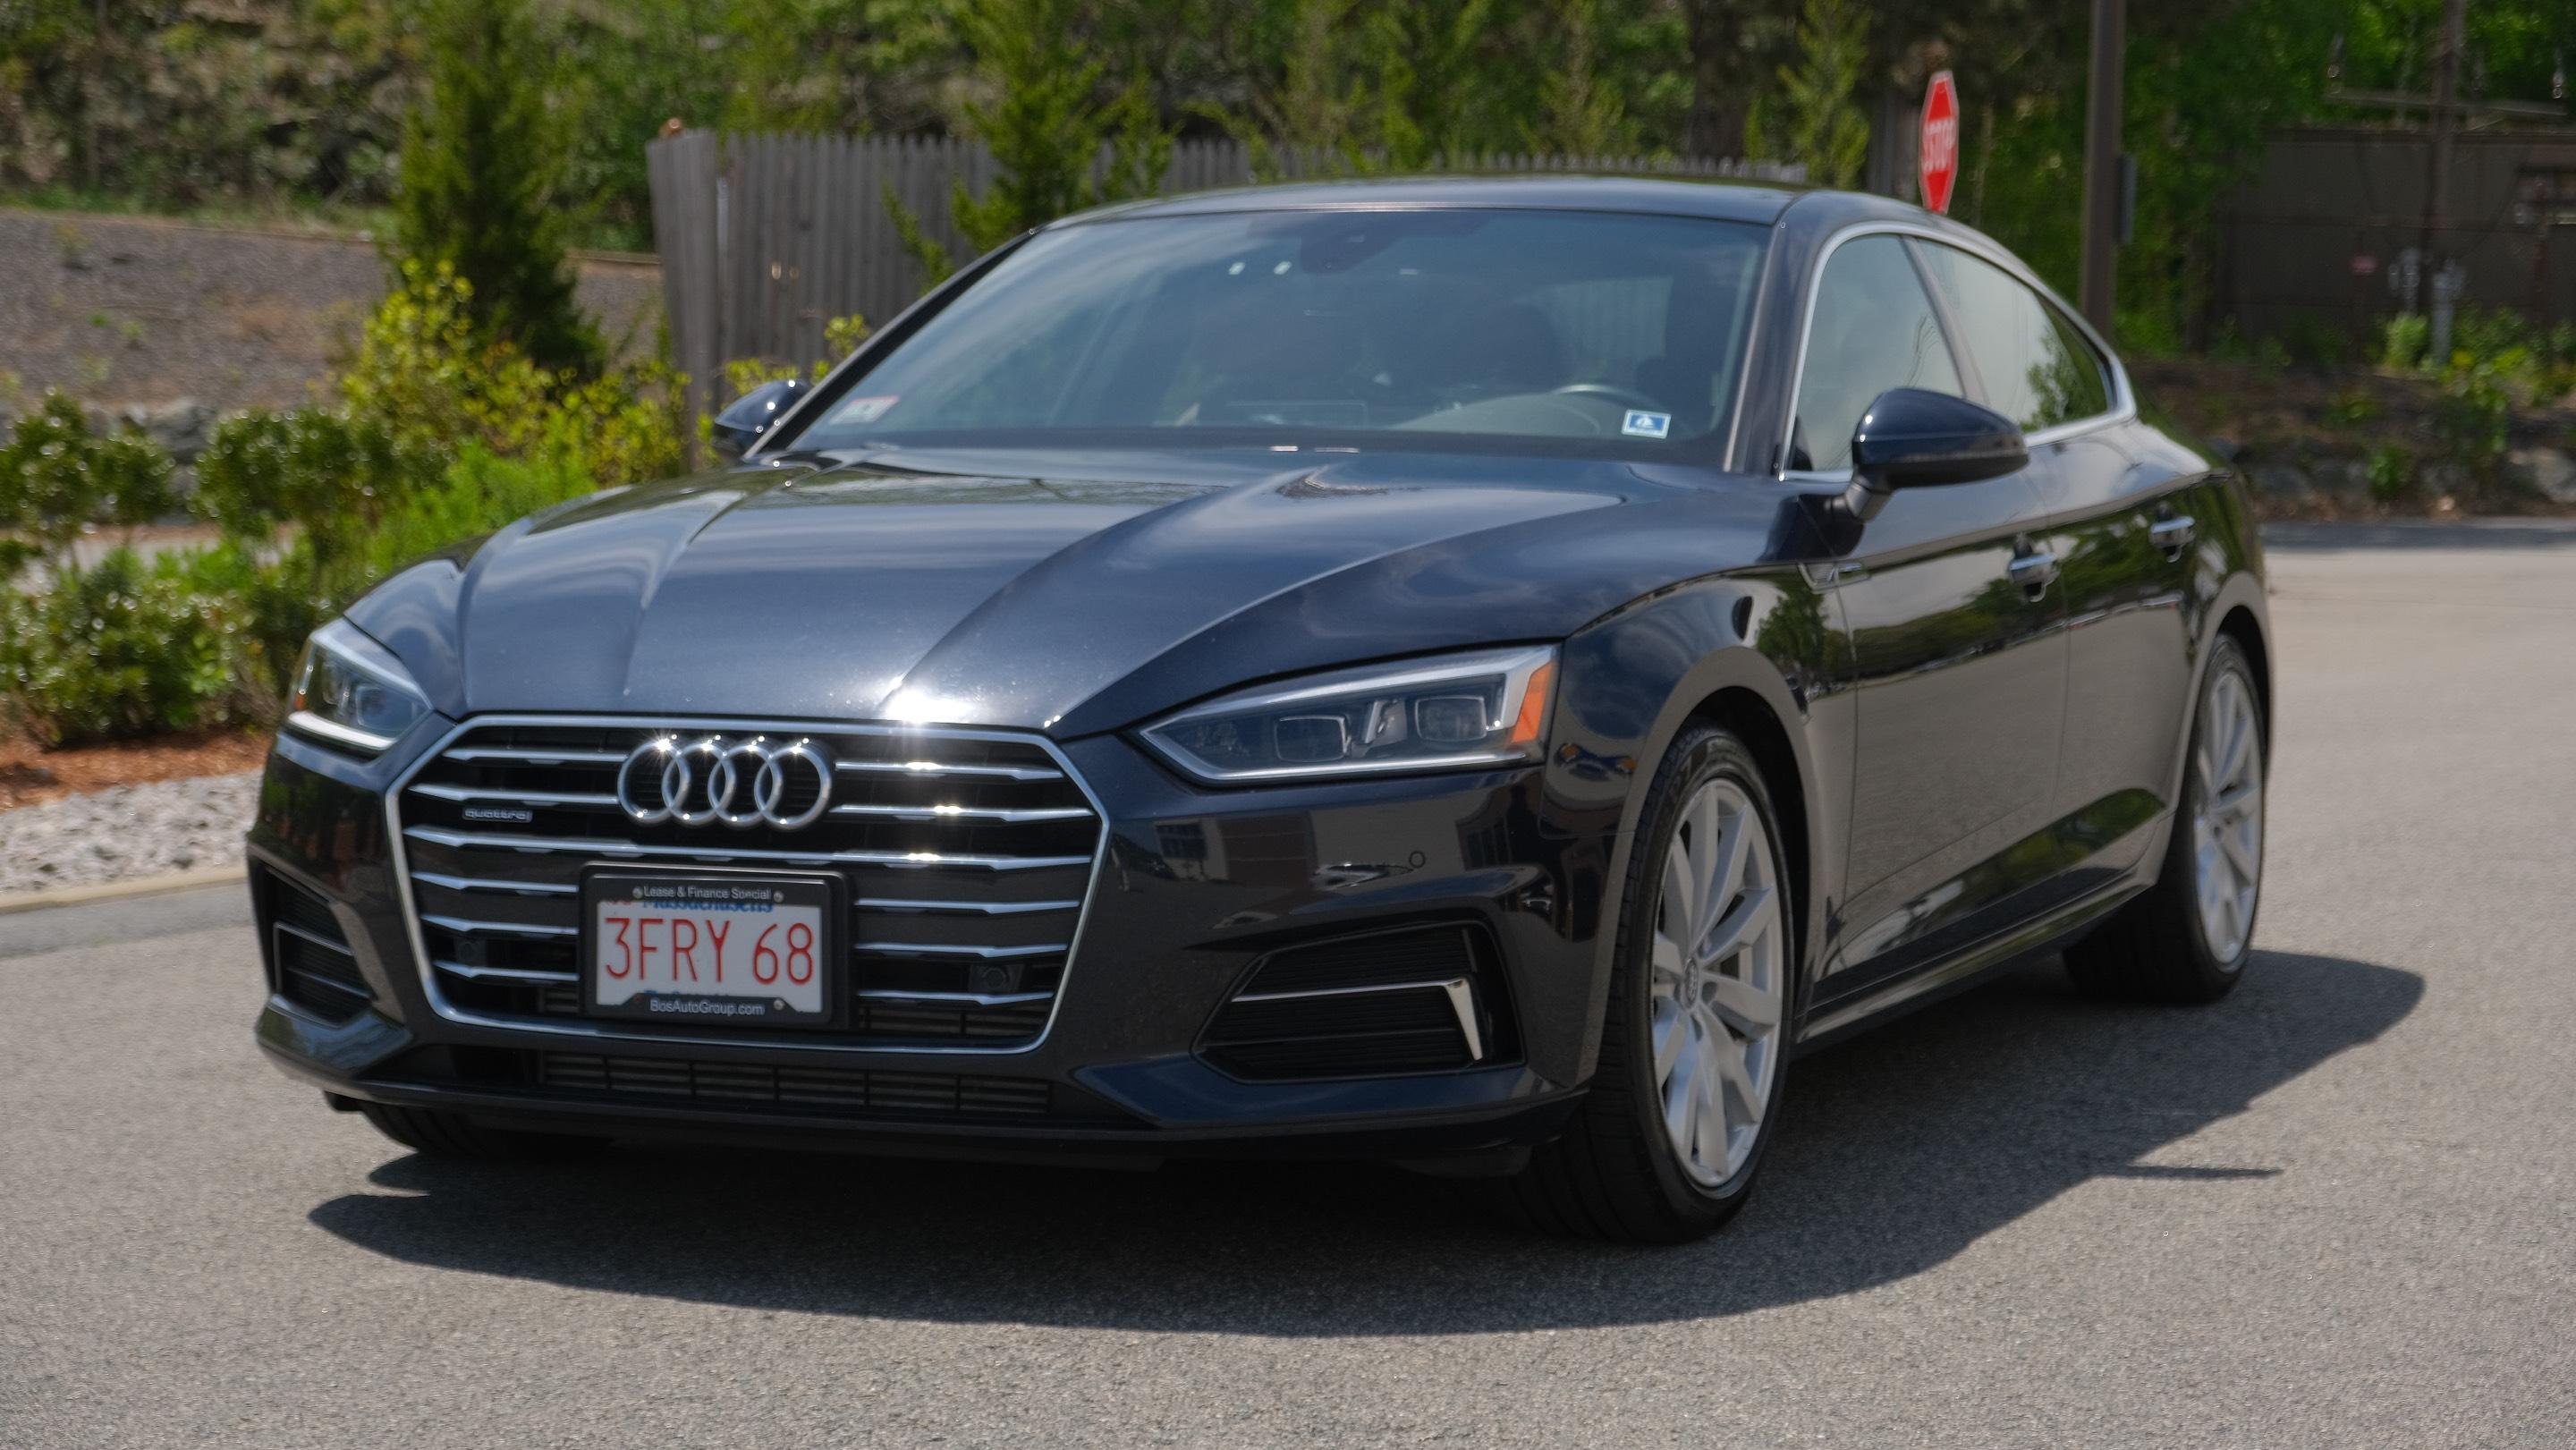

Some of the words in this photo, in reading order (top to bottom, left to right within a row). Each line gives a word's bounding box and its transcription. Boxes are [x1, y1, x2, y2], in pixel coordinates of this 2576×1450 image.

[1922, 117, 1956, 174] STOP
[464, 808, 526, 820] quattro
[643, 886, 674, 897] Lease
[677, 886, 686, 897] &
[687, 886, 729, 899] Finance
[731, 887, 771, 900] Special
[605, 917, 731, 983] 3FRY
[752, 922, 814, 986] 68
[650, 998, 766, 1016] BosAutoGroup.com
